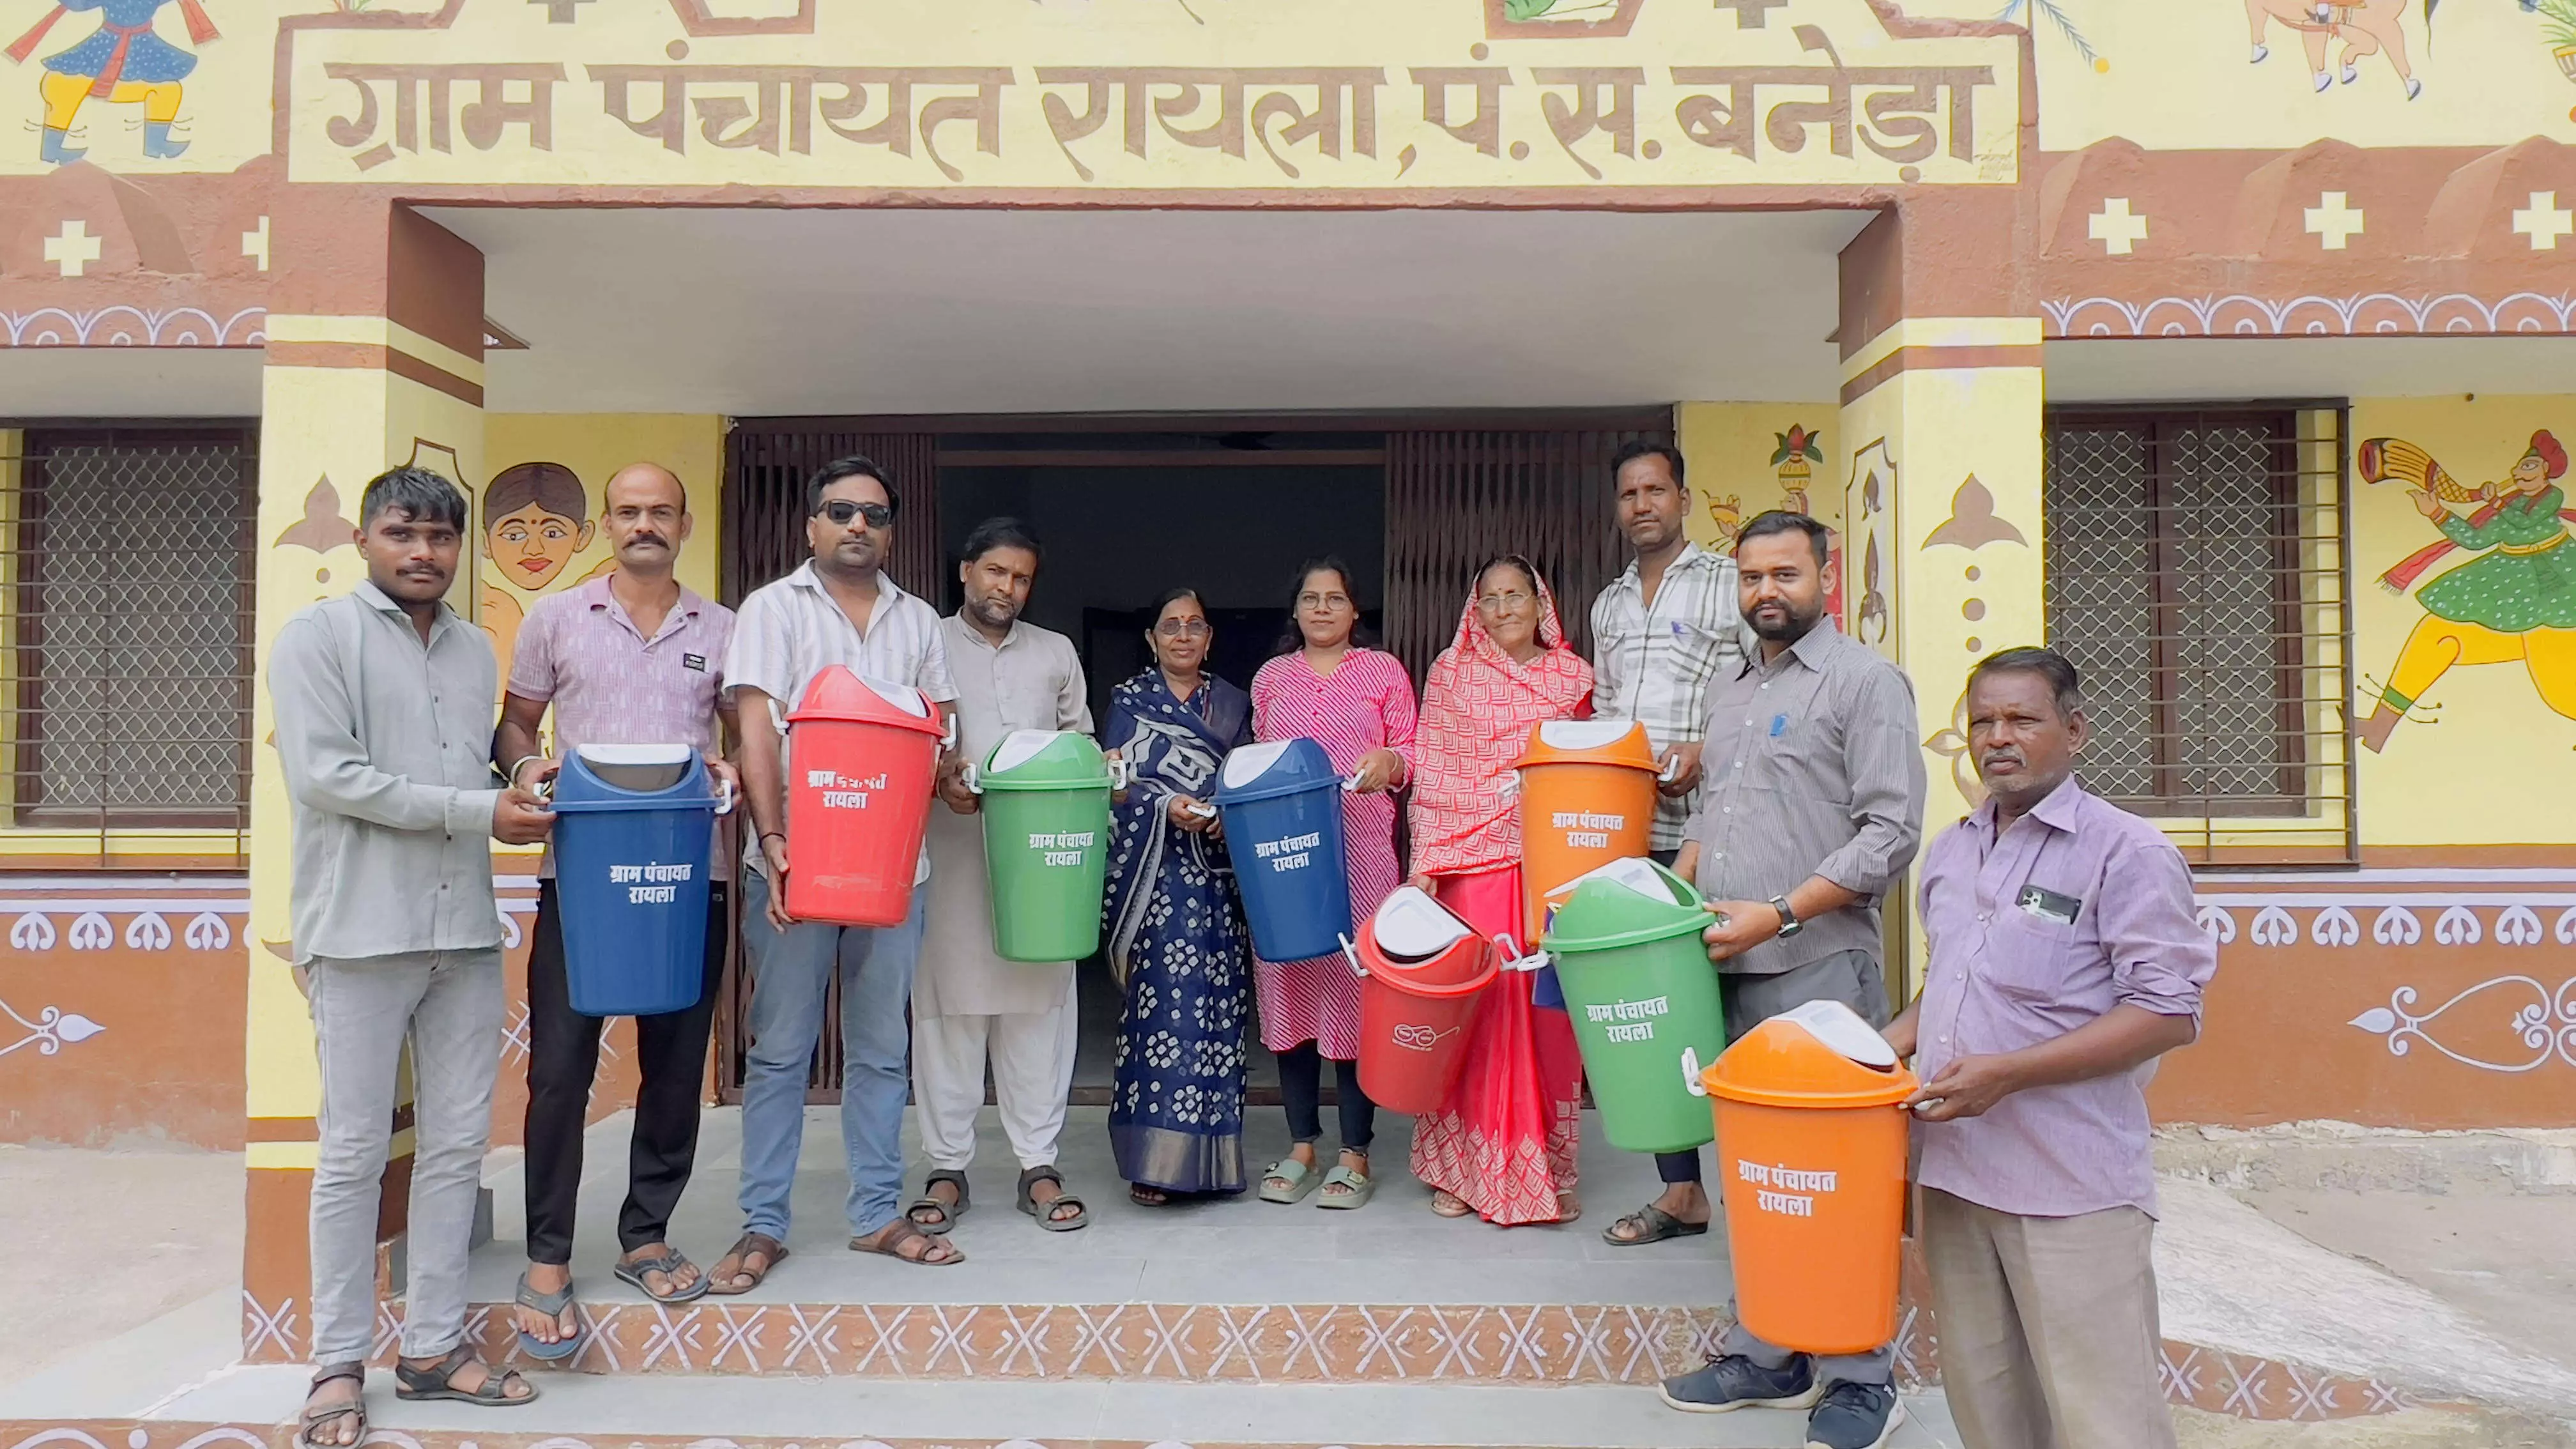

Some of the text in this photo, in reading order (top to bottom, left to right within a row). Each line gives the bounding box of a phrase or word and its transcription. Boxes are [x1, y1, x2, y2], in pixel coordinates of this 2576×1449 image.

[323, 62, 569, 171] ग्राम
[584, 40, 1016, 182] पंचायत
[808, 770, 836, 788] ग्राम
[823, 791, 868, 809] रायला
[1552, 809, 1625, 830] ग्राम पंचायत
[1029, 830, 1094, 848] ग्राम पंचायत
[1254, 832, 1320, 858] ग्राम पंचायत
[1567, 831, 1608, 848] रायला
[1045, 850, 1082, 866] रायला
[1271, 852, 1310, 872] रायला
[610, 861, 693, 883] ग्राम पंचायत
[629, 885, 676, 903] रायला
[1585, 995, 1668, 1022] ग्राम पंचायत
[1604, 1022, 1654, 1043] रायला
[1738, 1159, 1837, 1192] ग्राम पंचायत
[1757, 1189, 1813, 1217] रायला
